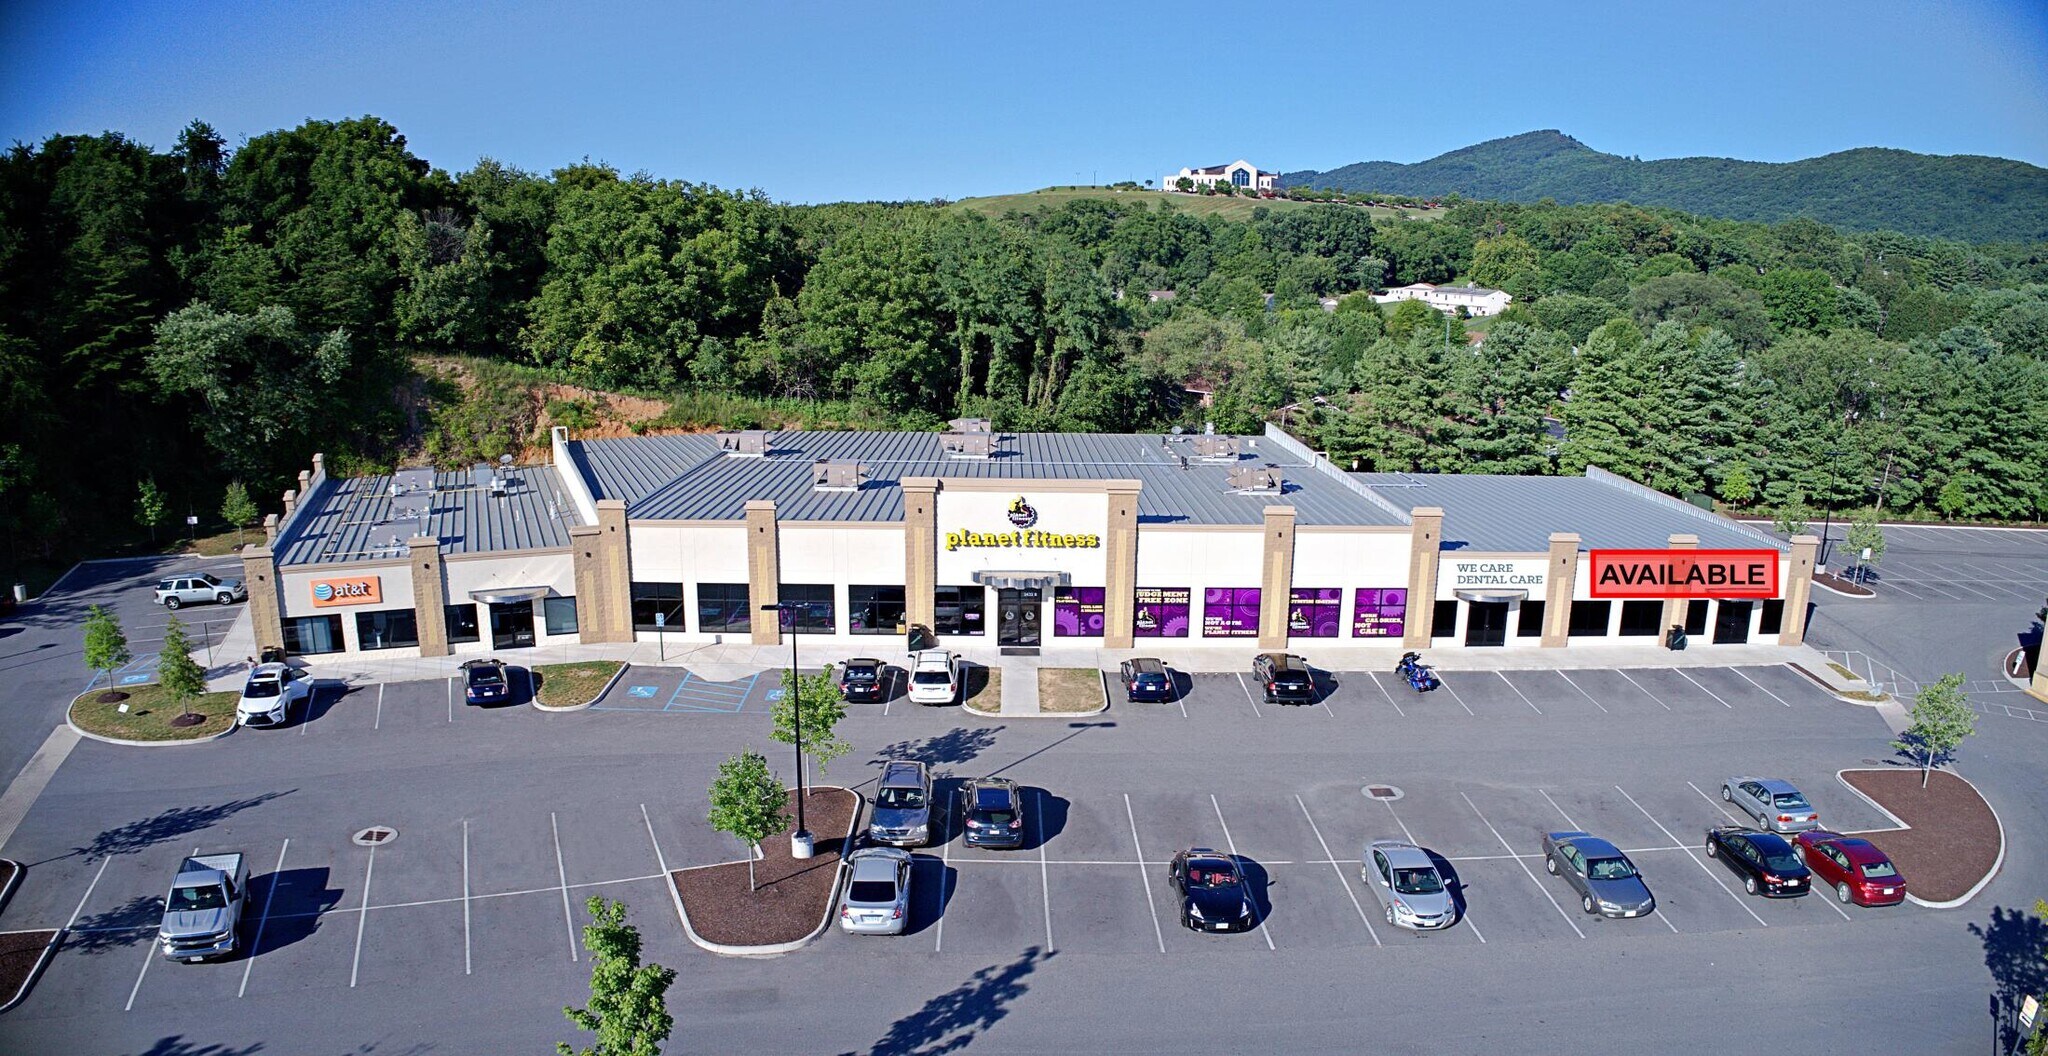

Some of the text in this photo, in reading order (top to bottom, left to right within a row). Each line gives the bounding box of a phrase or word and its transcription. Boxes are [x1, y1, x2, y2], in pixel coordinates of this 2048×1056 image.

[945, 528, 1097, 550] planet fitness
[1457, 563, 1513, 572] WE CARE
[1457, 575, 1543, 584] DENTAL CARE
[334, 582, 367, 597] at&t
